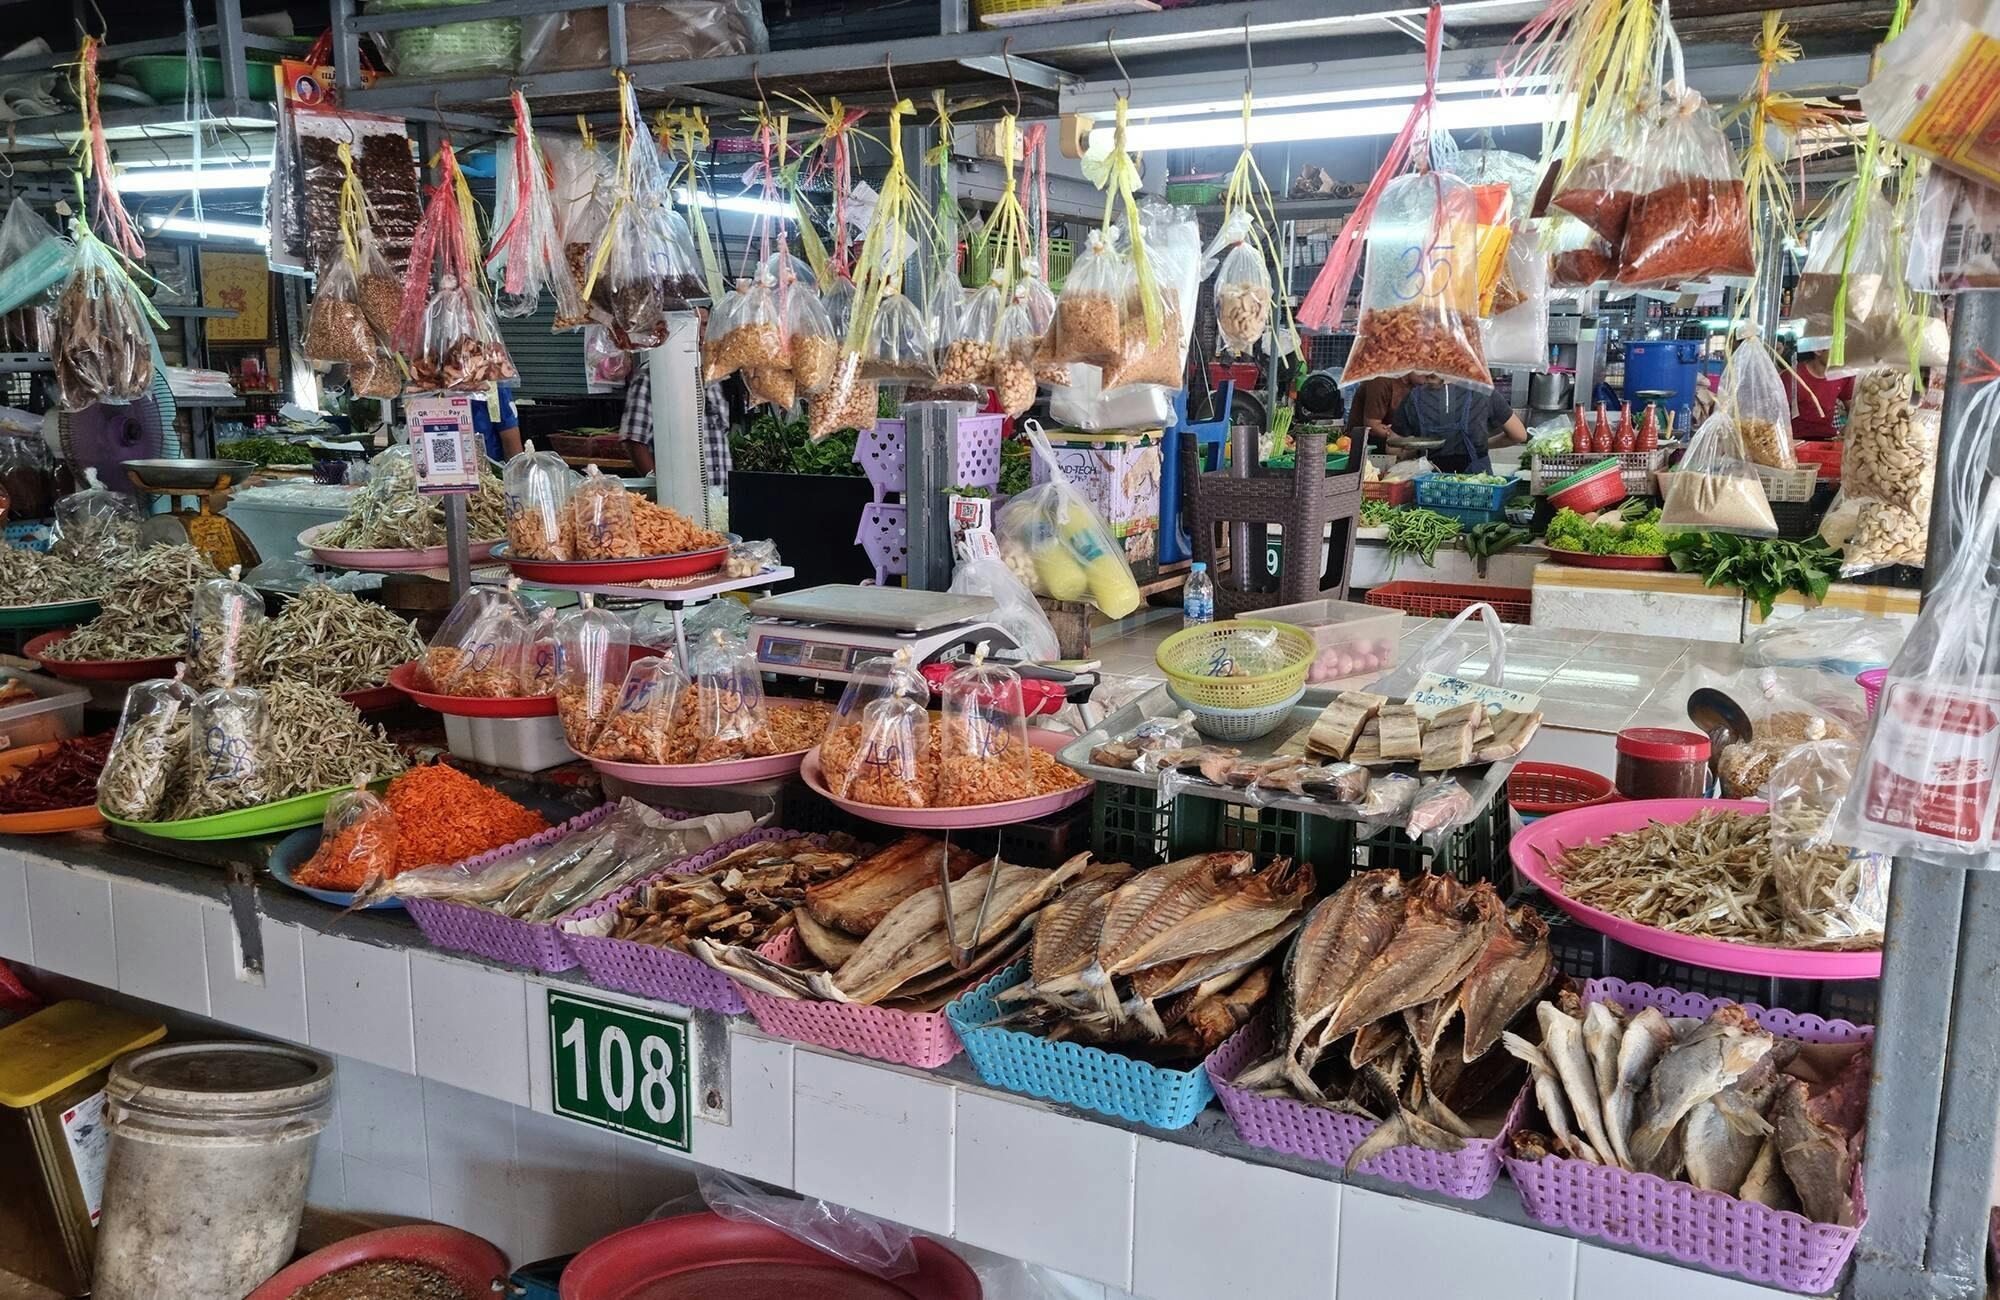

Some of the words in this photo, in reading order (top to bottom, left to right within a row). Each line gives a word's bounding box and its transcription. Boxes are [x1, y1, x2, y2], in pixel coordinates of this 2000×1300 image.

[1392, 245, 1455, 300] 35
[1208, 648, 1234, 677] 30
[720, 676, 759, 713] 30
[865, 740, 904, 789] 40
[561, 1017, 677, 1124] 108
